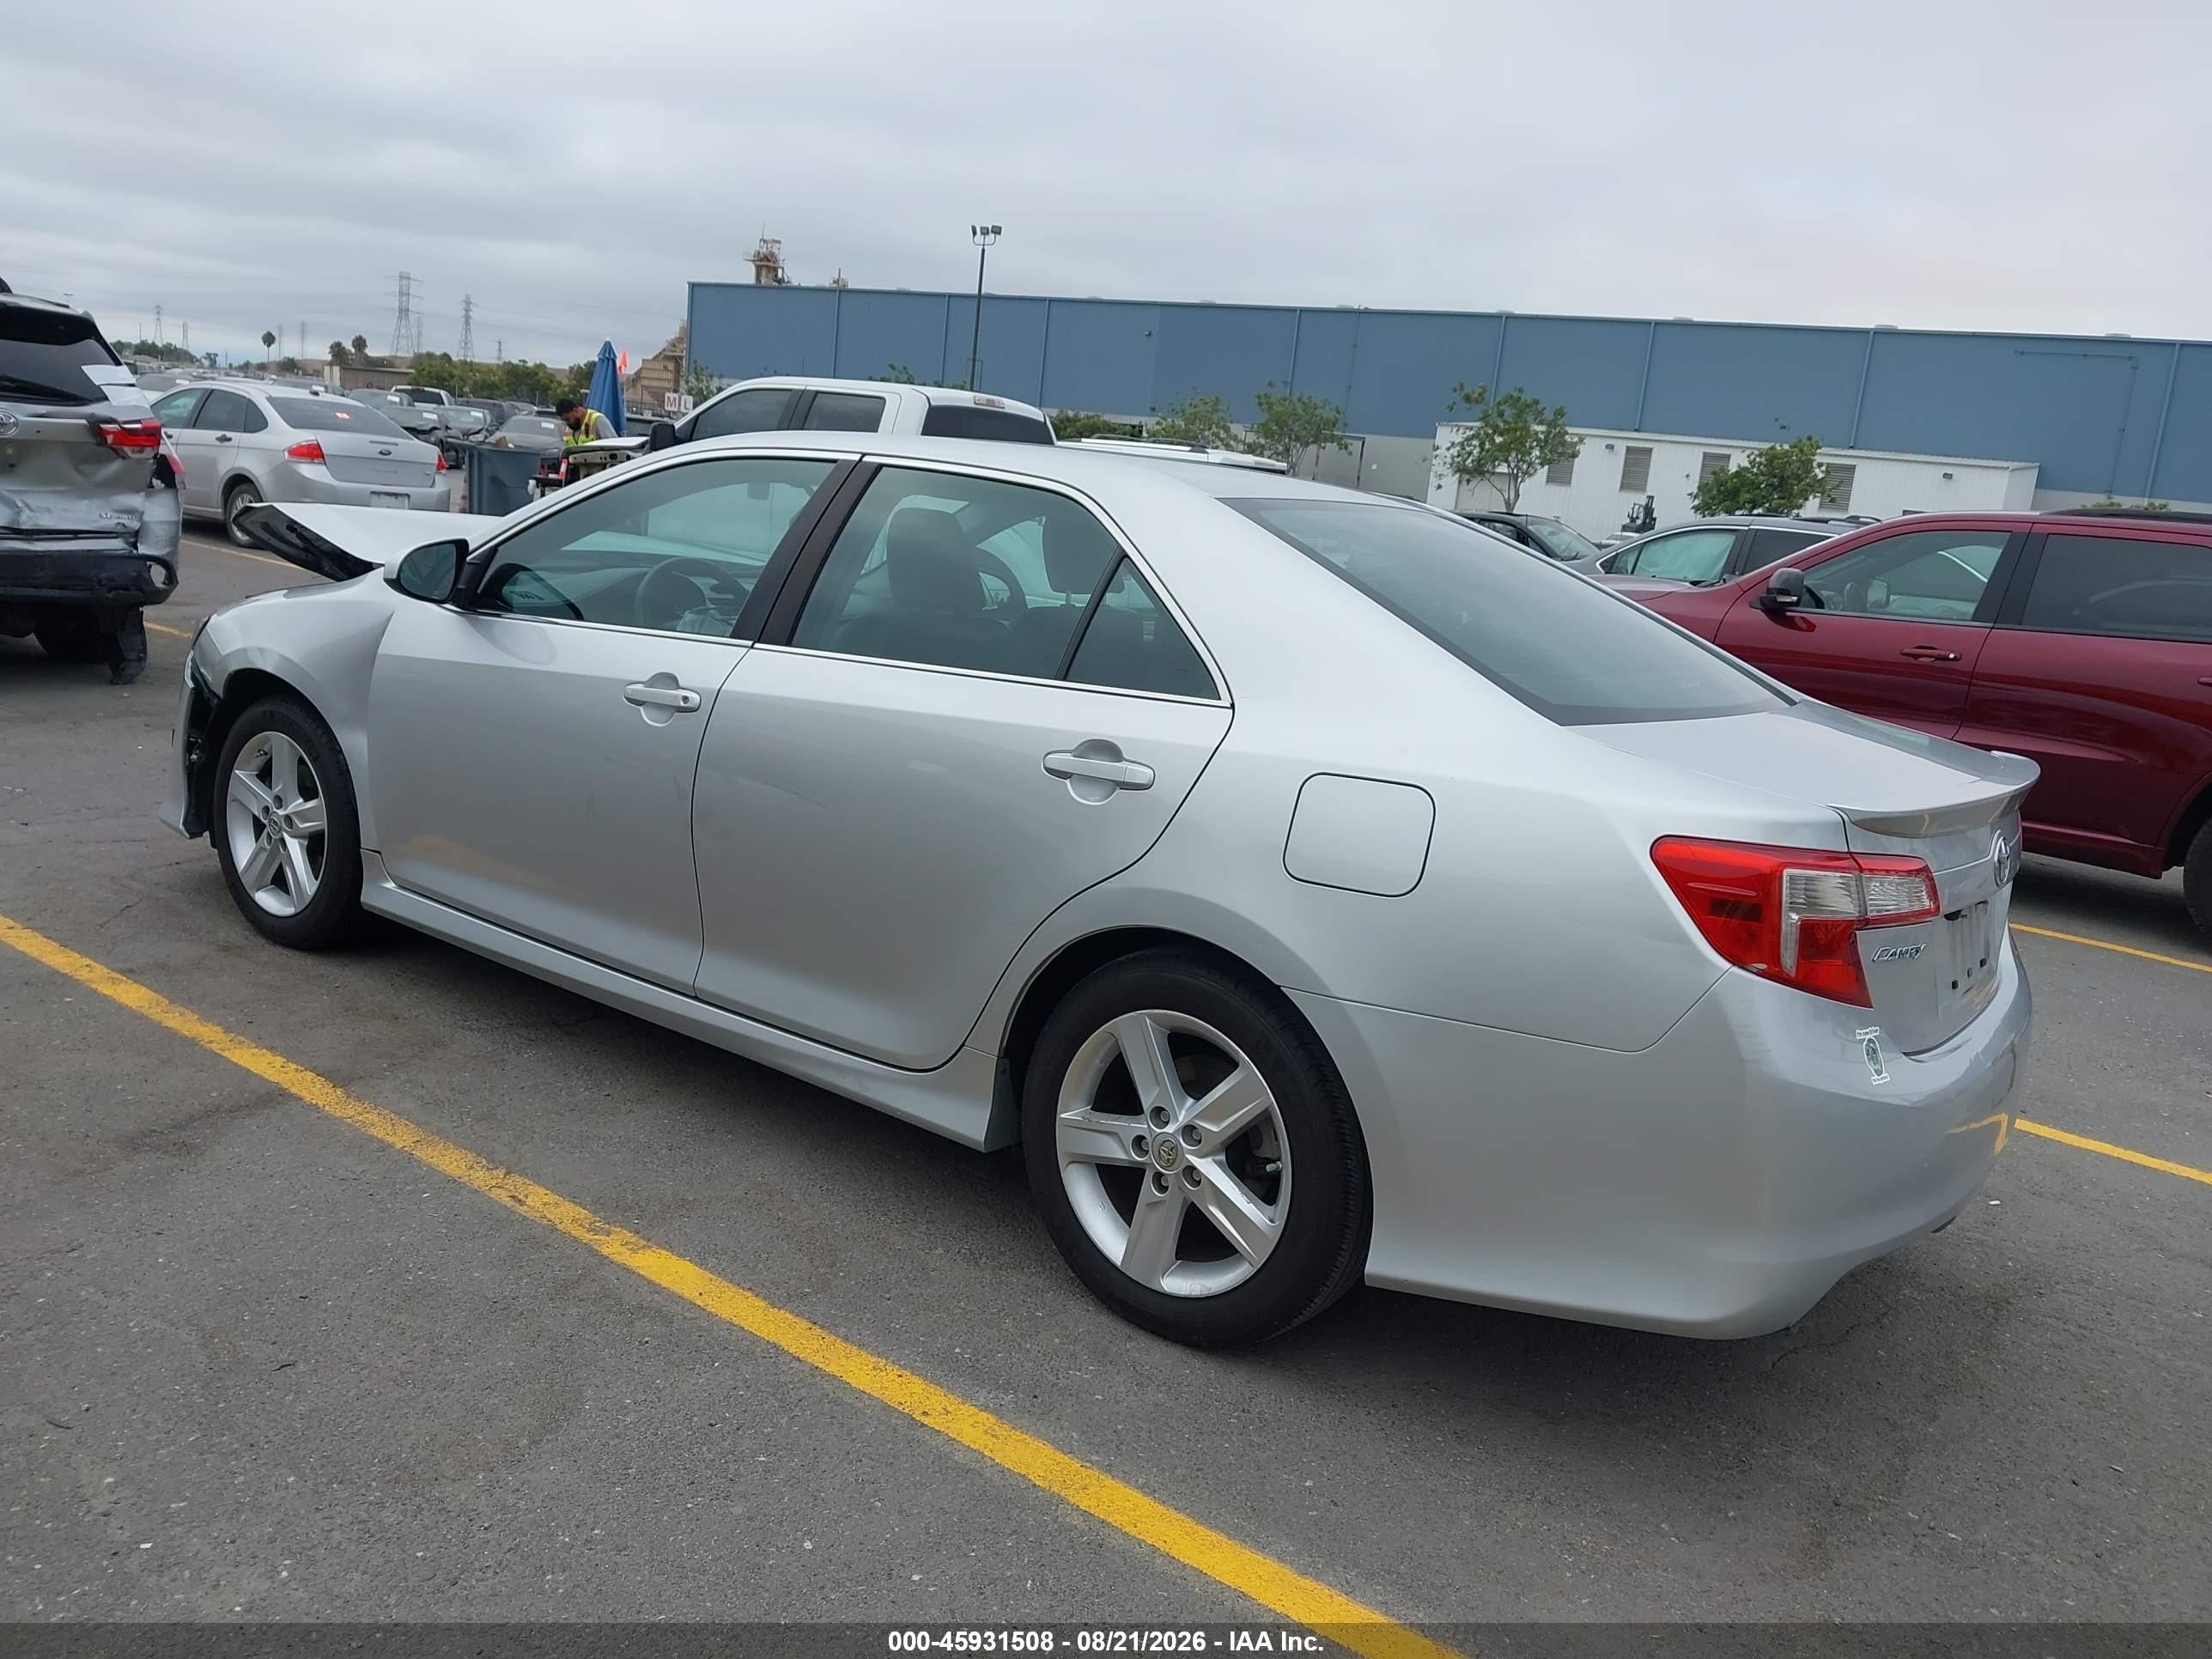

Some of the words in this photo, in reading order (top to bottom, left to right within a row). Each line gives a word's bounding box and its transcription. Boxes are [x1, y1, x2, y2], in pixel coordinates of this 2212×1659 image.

[666, 396, 677, 408] M
[684, 398, 690, 410] L
[1871, 944, 1926, 962] CAMRY
